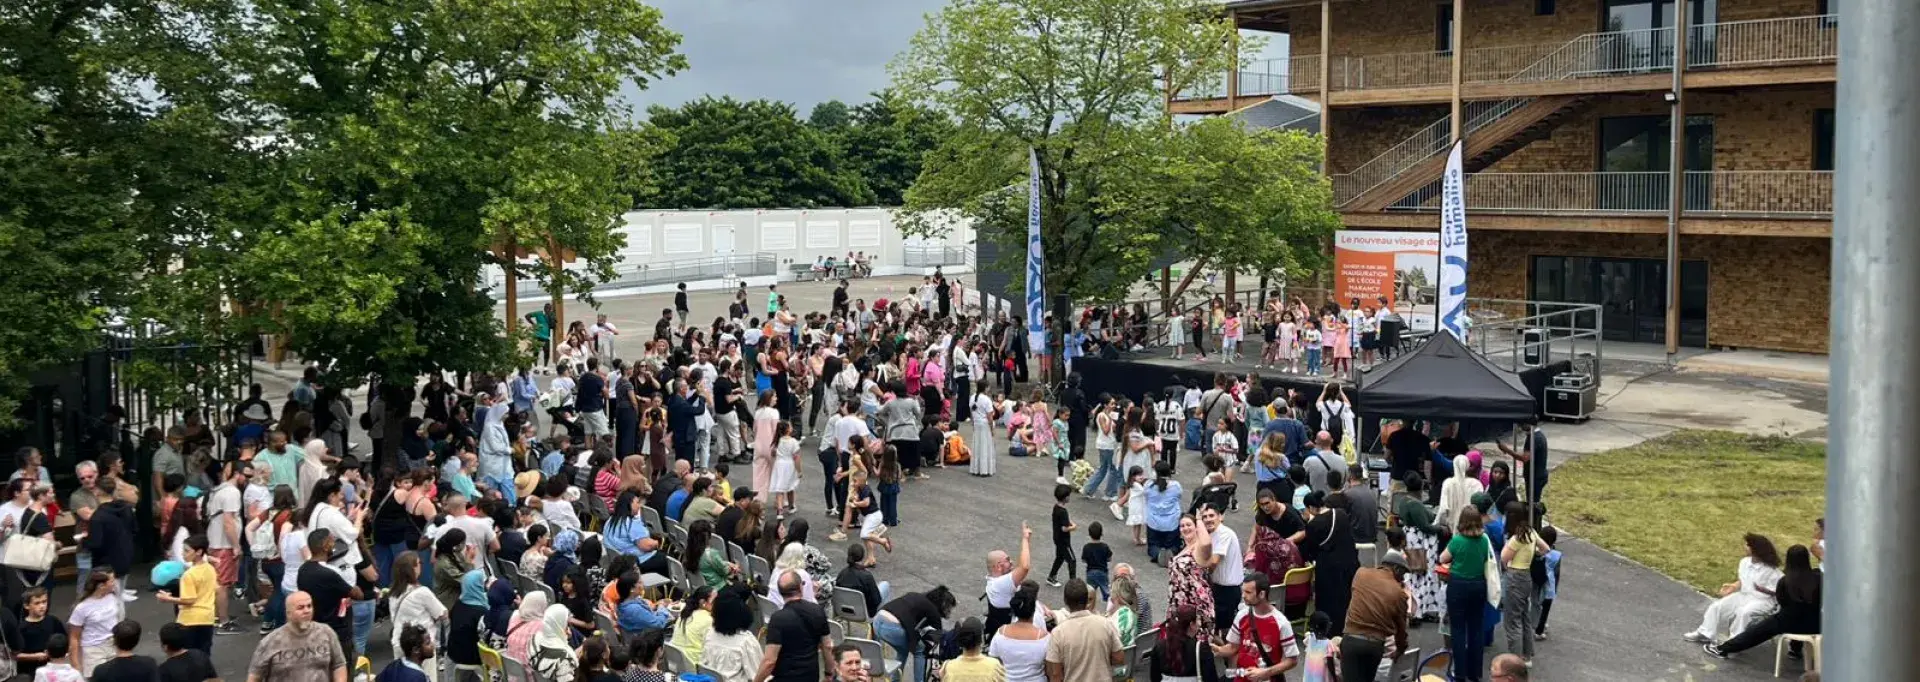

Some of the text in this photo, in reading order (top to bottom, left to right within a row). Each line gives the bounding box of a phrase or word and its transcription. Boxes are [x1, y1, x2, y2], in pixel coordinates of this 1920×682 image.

[1341, 235, 1352, 244] Le
[1354, 237, 1392, 245] nouveau
[1395, 236, 1424, 247] visage
[1160, 418, 1176, 434] 10
